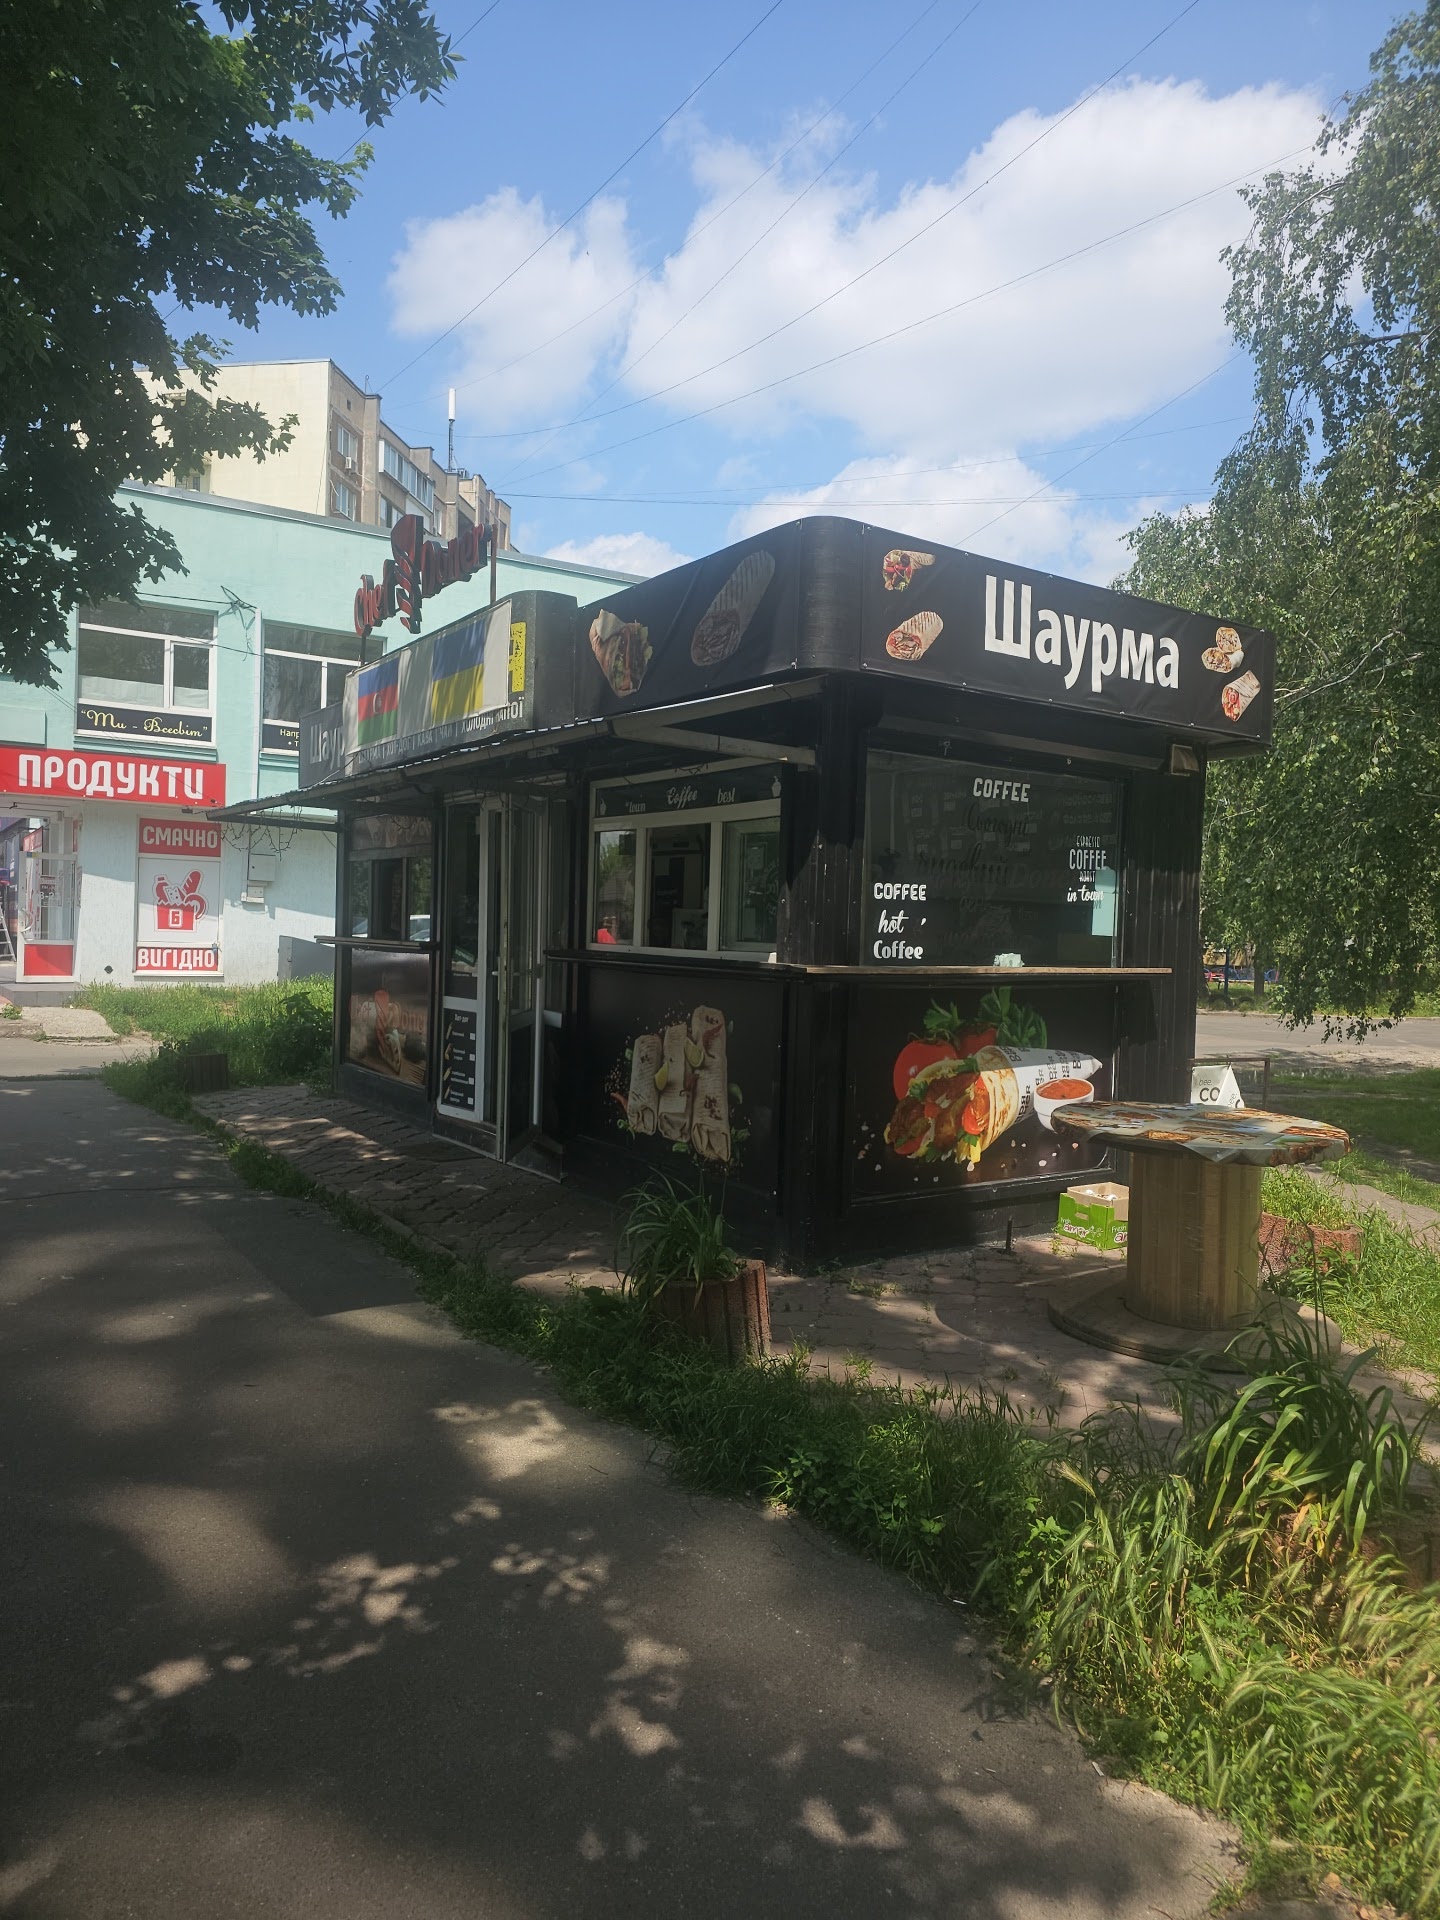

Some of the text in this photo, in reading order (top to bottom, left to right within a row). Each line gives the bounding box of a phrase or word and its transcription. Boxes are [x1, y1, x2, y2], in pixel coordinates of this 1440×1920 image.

[984, 574, 1180, 693] Шаурма
[18, 754, 205, 800] ПРОДУКТИ
[666, 785, 698, 809] Coffee
[972, 777, 1031, 803] COFFEE
[142, 825, 218, 849] СМАЧНО
[1069, 848, 1107, 870] COFFEE
[873, 882, 927, 902] COFFEE
[1067, 884, 1104, 902] in town
[878, 909, 909, 934] hot
[137, 947, 215, 970] ВИГІДНО
[873, 940, 924, 960] Coffee
[1199, 1086, 1221, 1102] CO
